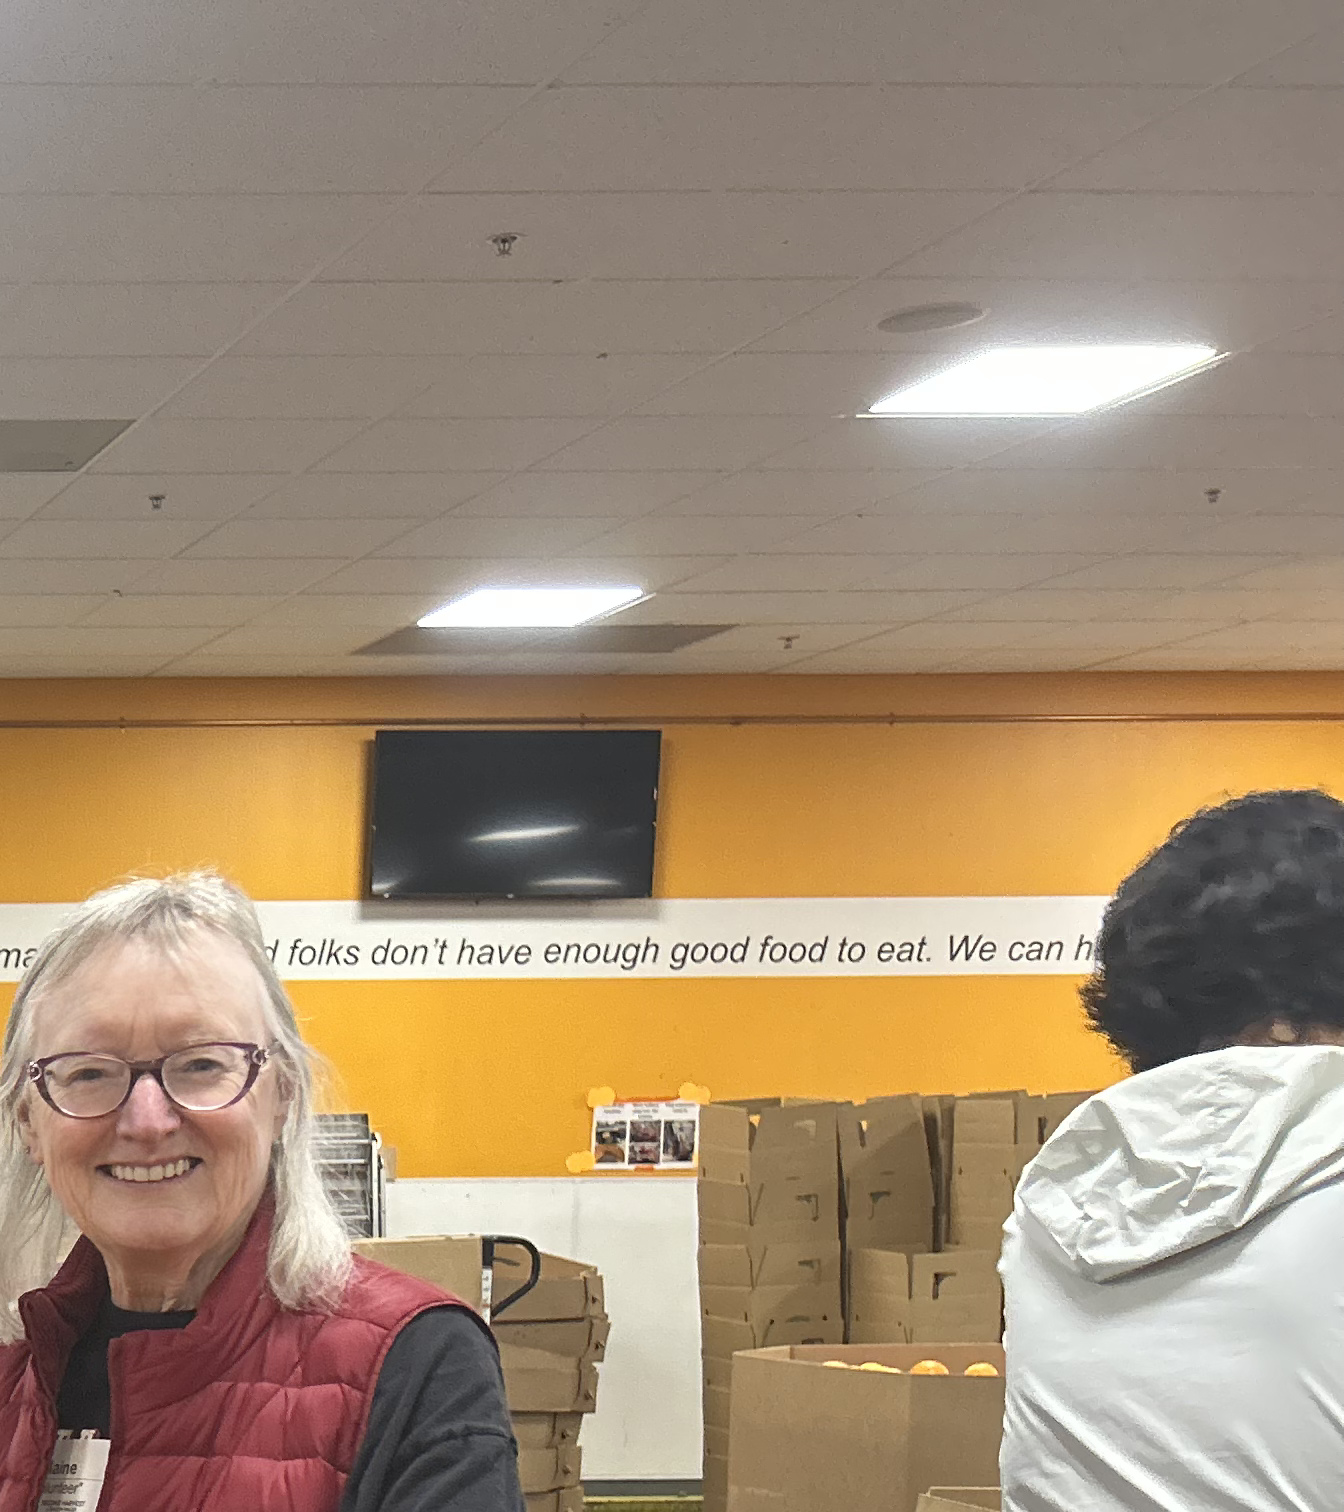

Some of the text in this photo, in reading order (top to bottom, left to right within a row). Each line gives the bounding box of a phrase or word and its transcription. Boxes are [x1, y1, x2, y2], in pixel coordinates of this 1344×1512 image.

[287, 938, 360, 966] folks
[371, 938, 448, 965] don’t
[457, 938, 532, 965] have
[544, 936, 660, 971] enough
[669, 936, 751, 971] good
[759, 935, 829, 963] food
[837, 937, 866, 963] to
[877, 936, 931, 963] eat.
[949, 934, 997, 962] We
[1008, 941, 1064, 961] can
